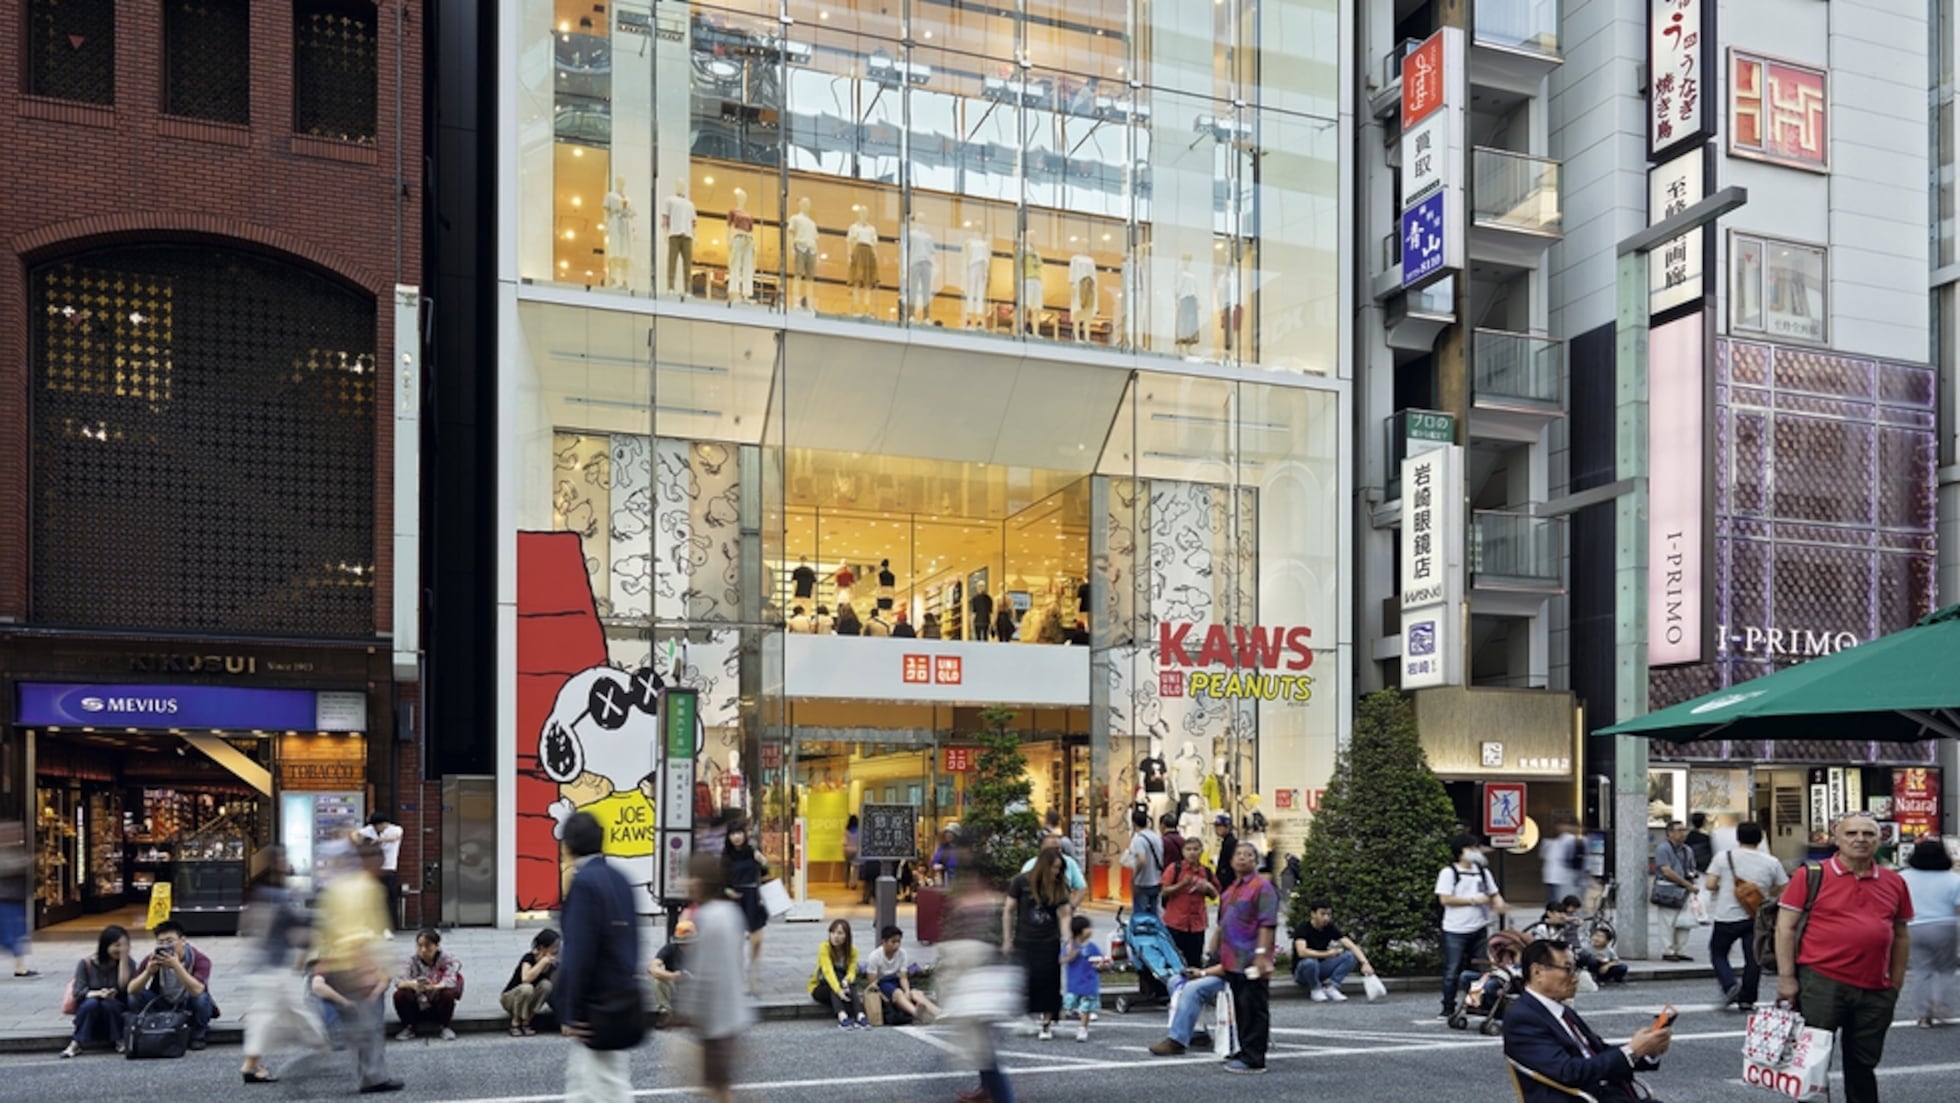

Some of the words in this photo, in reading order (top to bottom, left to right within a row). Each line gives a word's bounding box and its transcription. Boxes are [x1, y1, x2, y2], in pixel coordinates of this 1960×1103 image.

[1415, 130, 1432, 178] 買取
[1411, 413, 1449, 430] プロの
[1414, 462, 1432, 580] 岩崎眼鏡店
[1666, 531, 1683, 646] I-PRIMO
[1159, 620, 1314, 671] KAWS
[1717, 624, 1858, 656] I-PRIMO
[1189, 671, 1312, 701] PEANUTS
[107, 697, 178, 714] MEVIUS
[614, 805, 646, 825] JOE
[1896, 796, 1937, 816] Nataraj
[610, 825, 656, 843] KAWS
